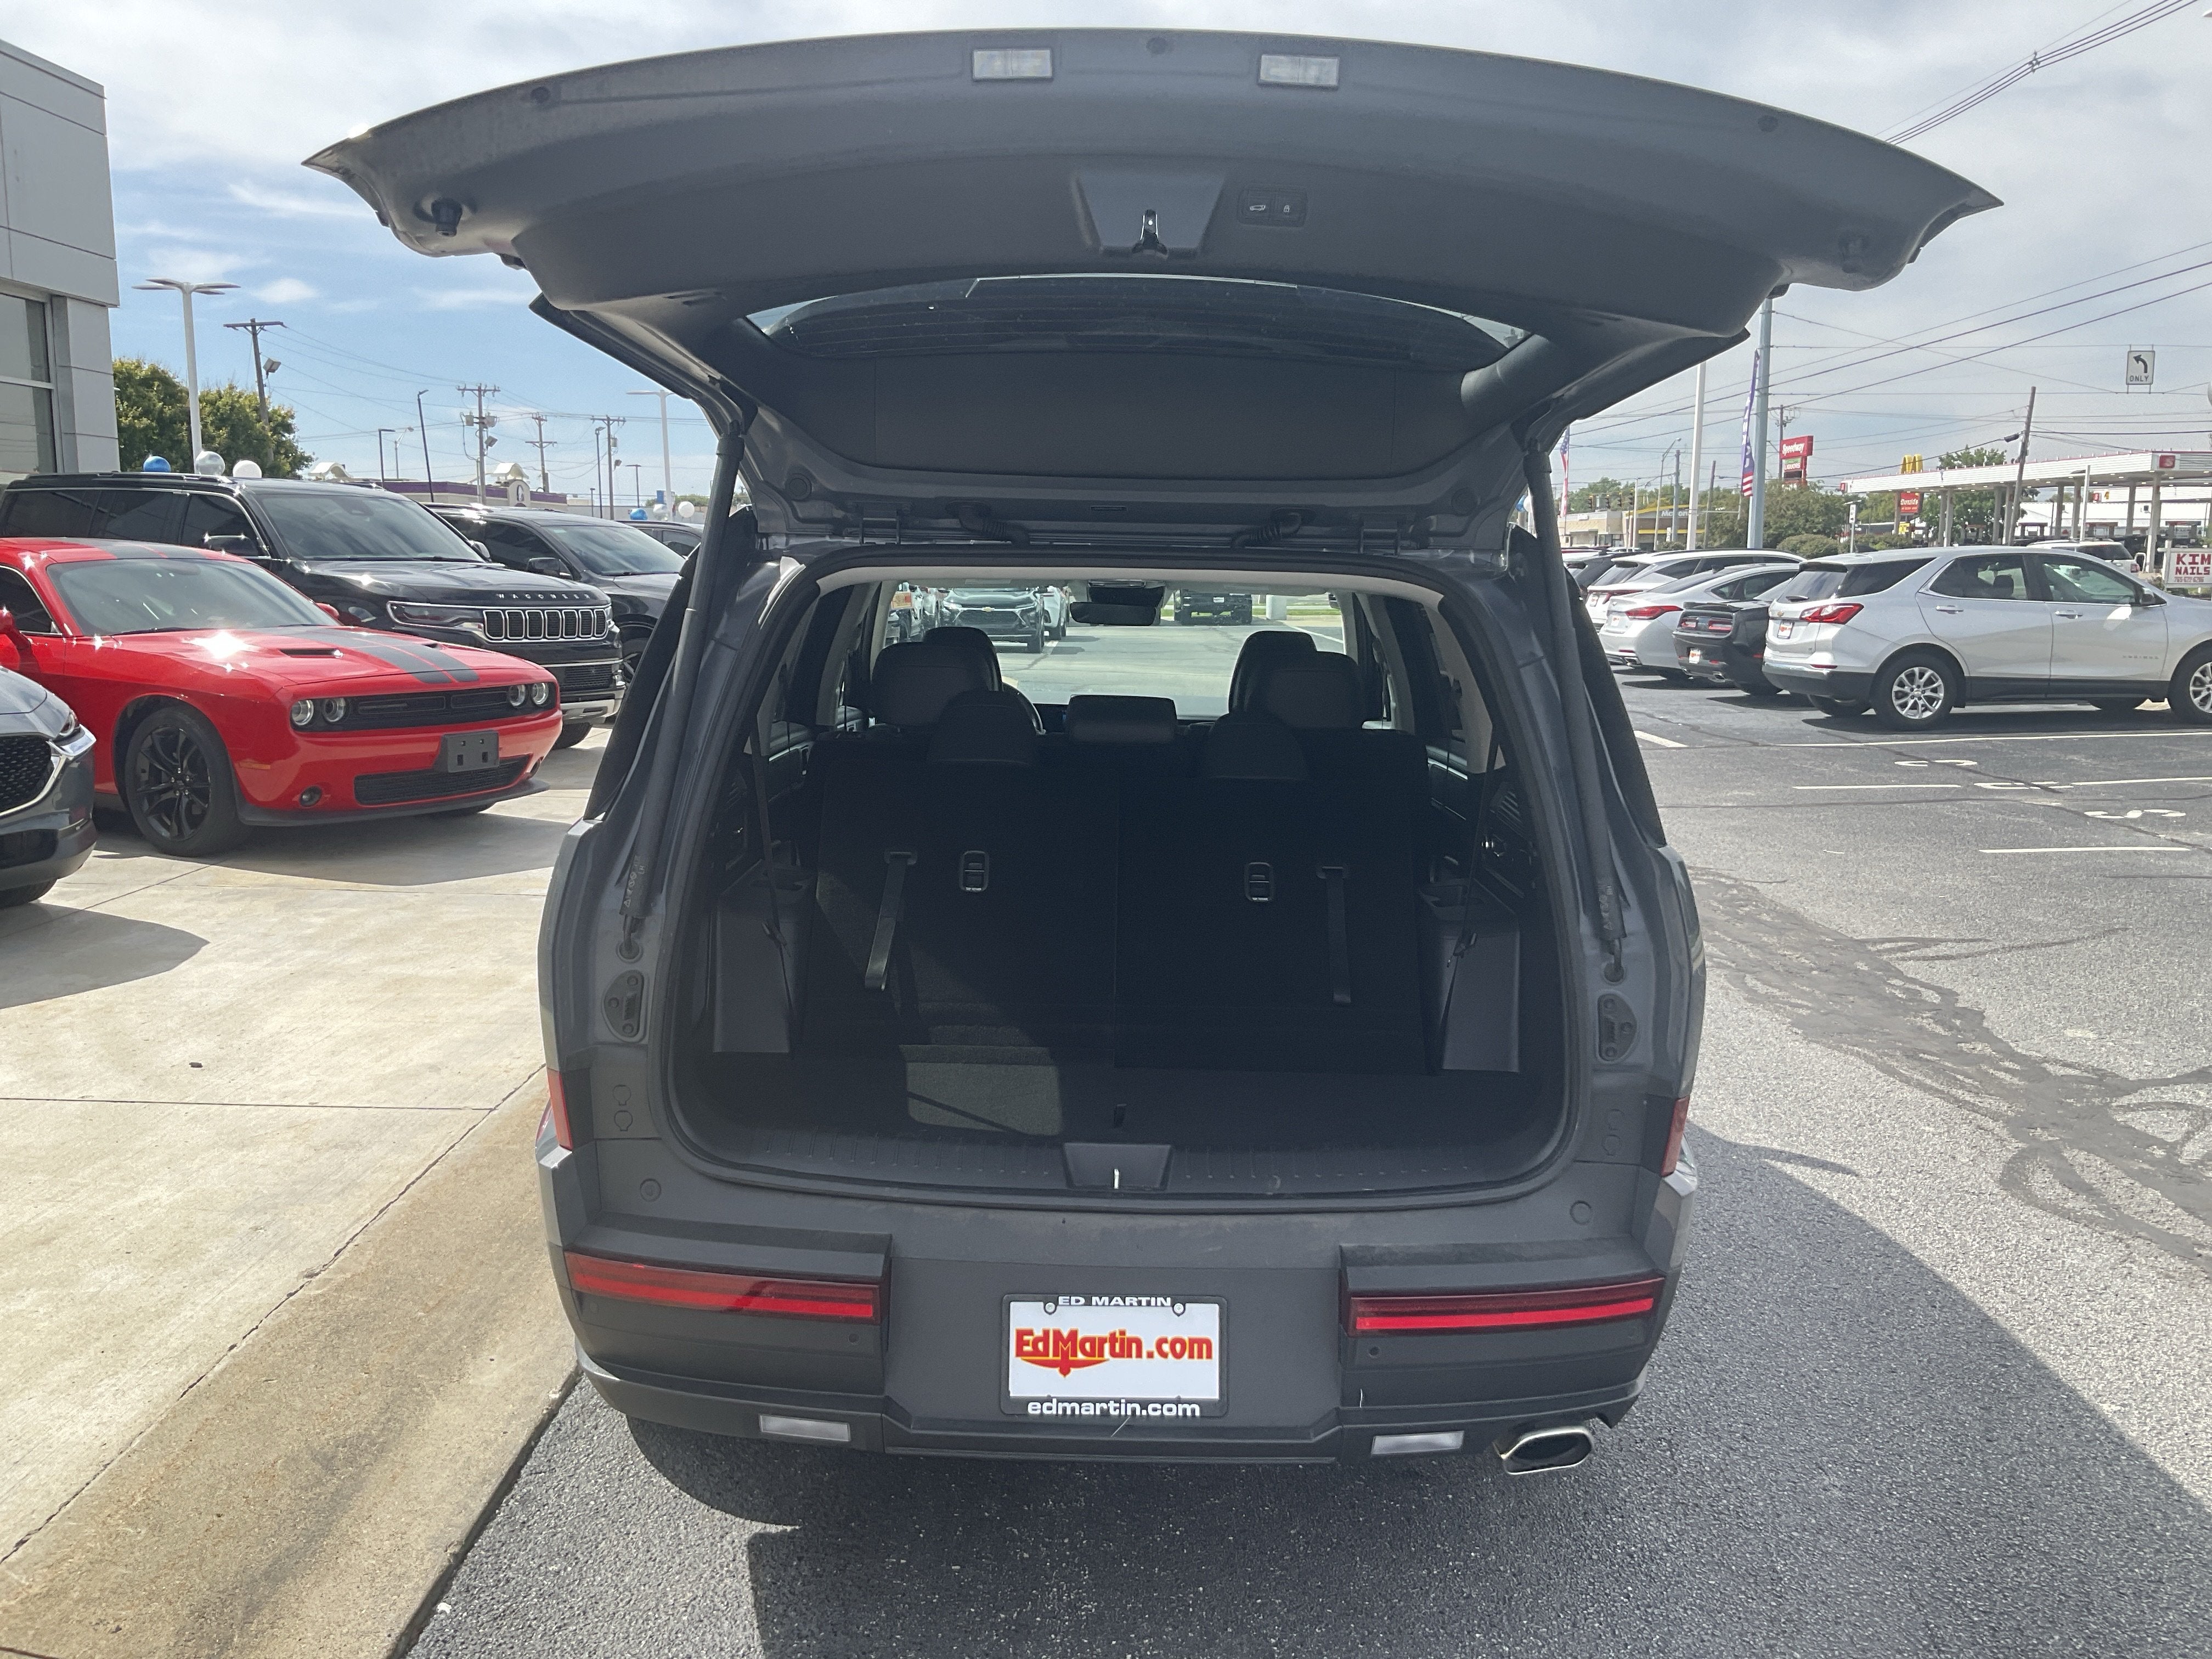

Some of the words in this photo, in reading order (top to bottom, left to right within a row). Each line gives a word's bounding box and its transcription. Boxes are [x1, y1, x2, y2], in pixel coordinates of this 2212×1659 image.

[1782, 442, 1805, 456] Speedway
[2176, 553, 2211, 565] KIM
[2175, 566, 2210, 575] NAILS
[1058, 1296, 1085, 1306] ED
[1091, 1296, 1171, 1307] MARTIN
[1015, 1328, 1214, 1367] EdMartin.com
[1027, 1398, 1200, 1417] edmartin.com
